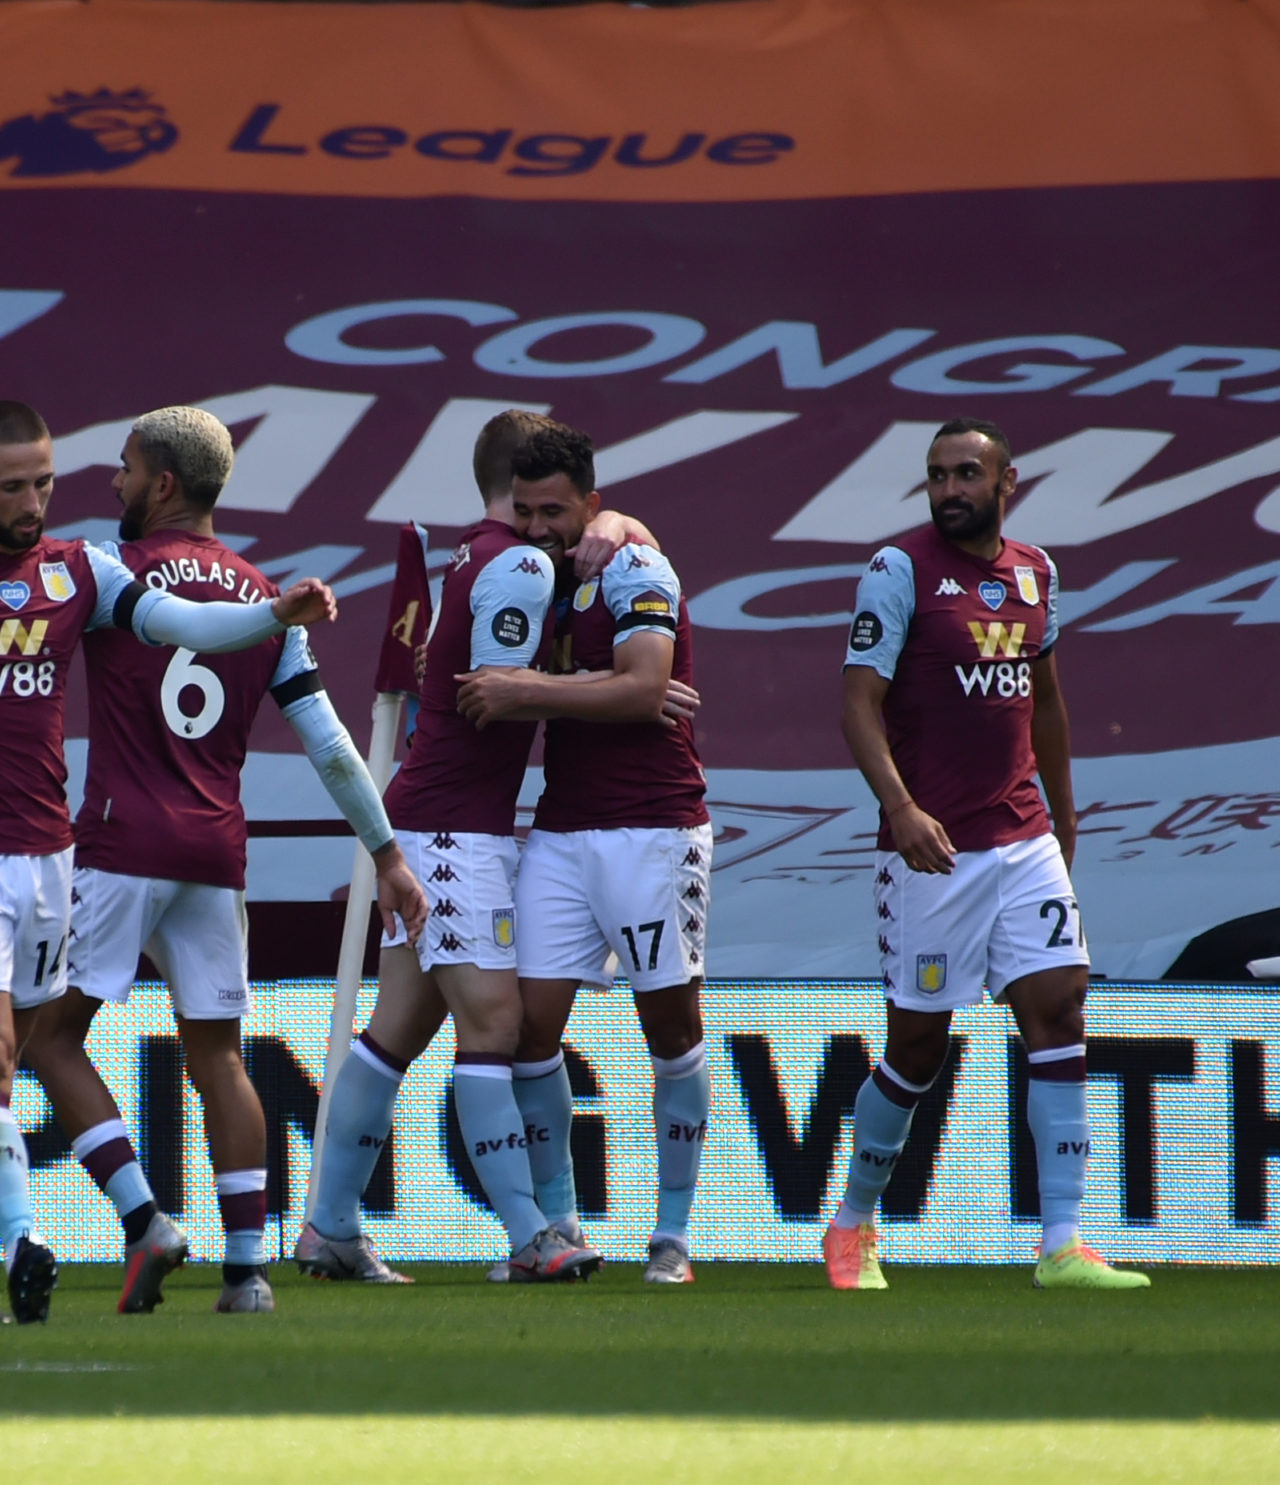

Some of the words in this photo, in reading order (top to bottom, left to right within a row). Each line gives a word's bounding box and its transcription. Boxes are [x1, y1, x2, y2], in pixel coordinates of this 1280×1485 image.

[228, 103, 796, 178] League
[284, 300, 1280, 402] CONGR
[161, 647, 225, 740] 6
[955, 662, 1032, 698] W88
[621, 919, 666, 972] 17
